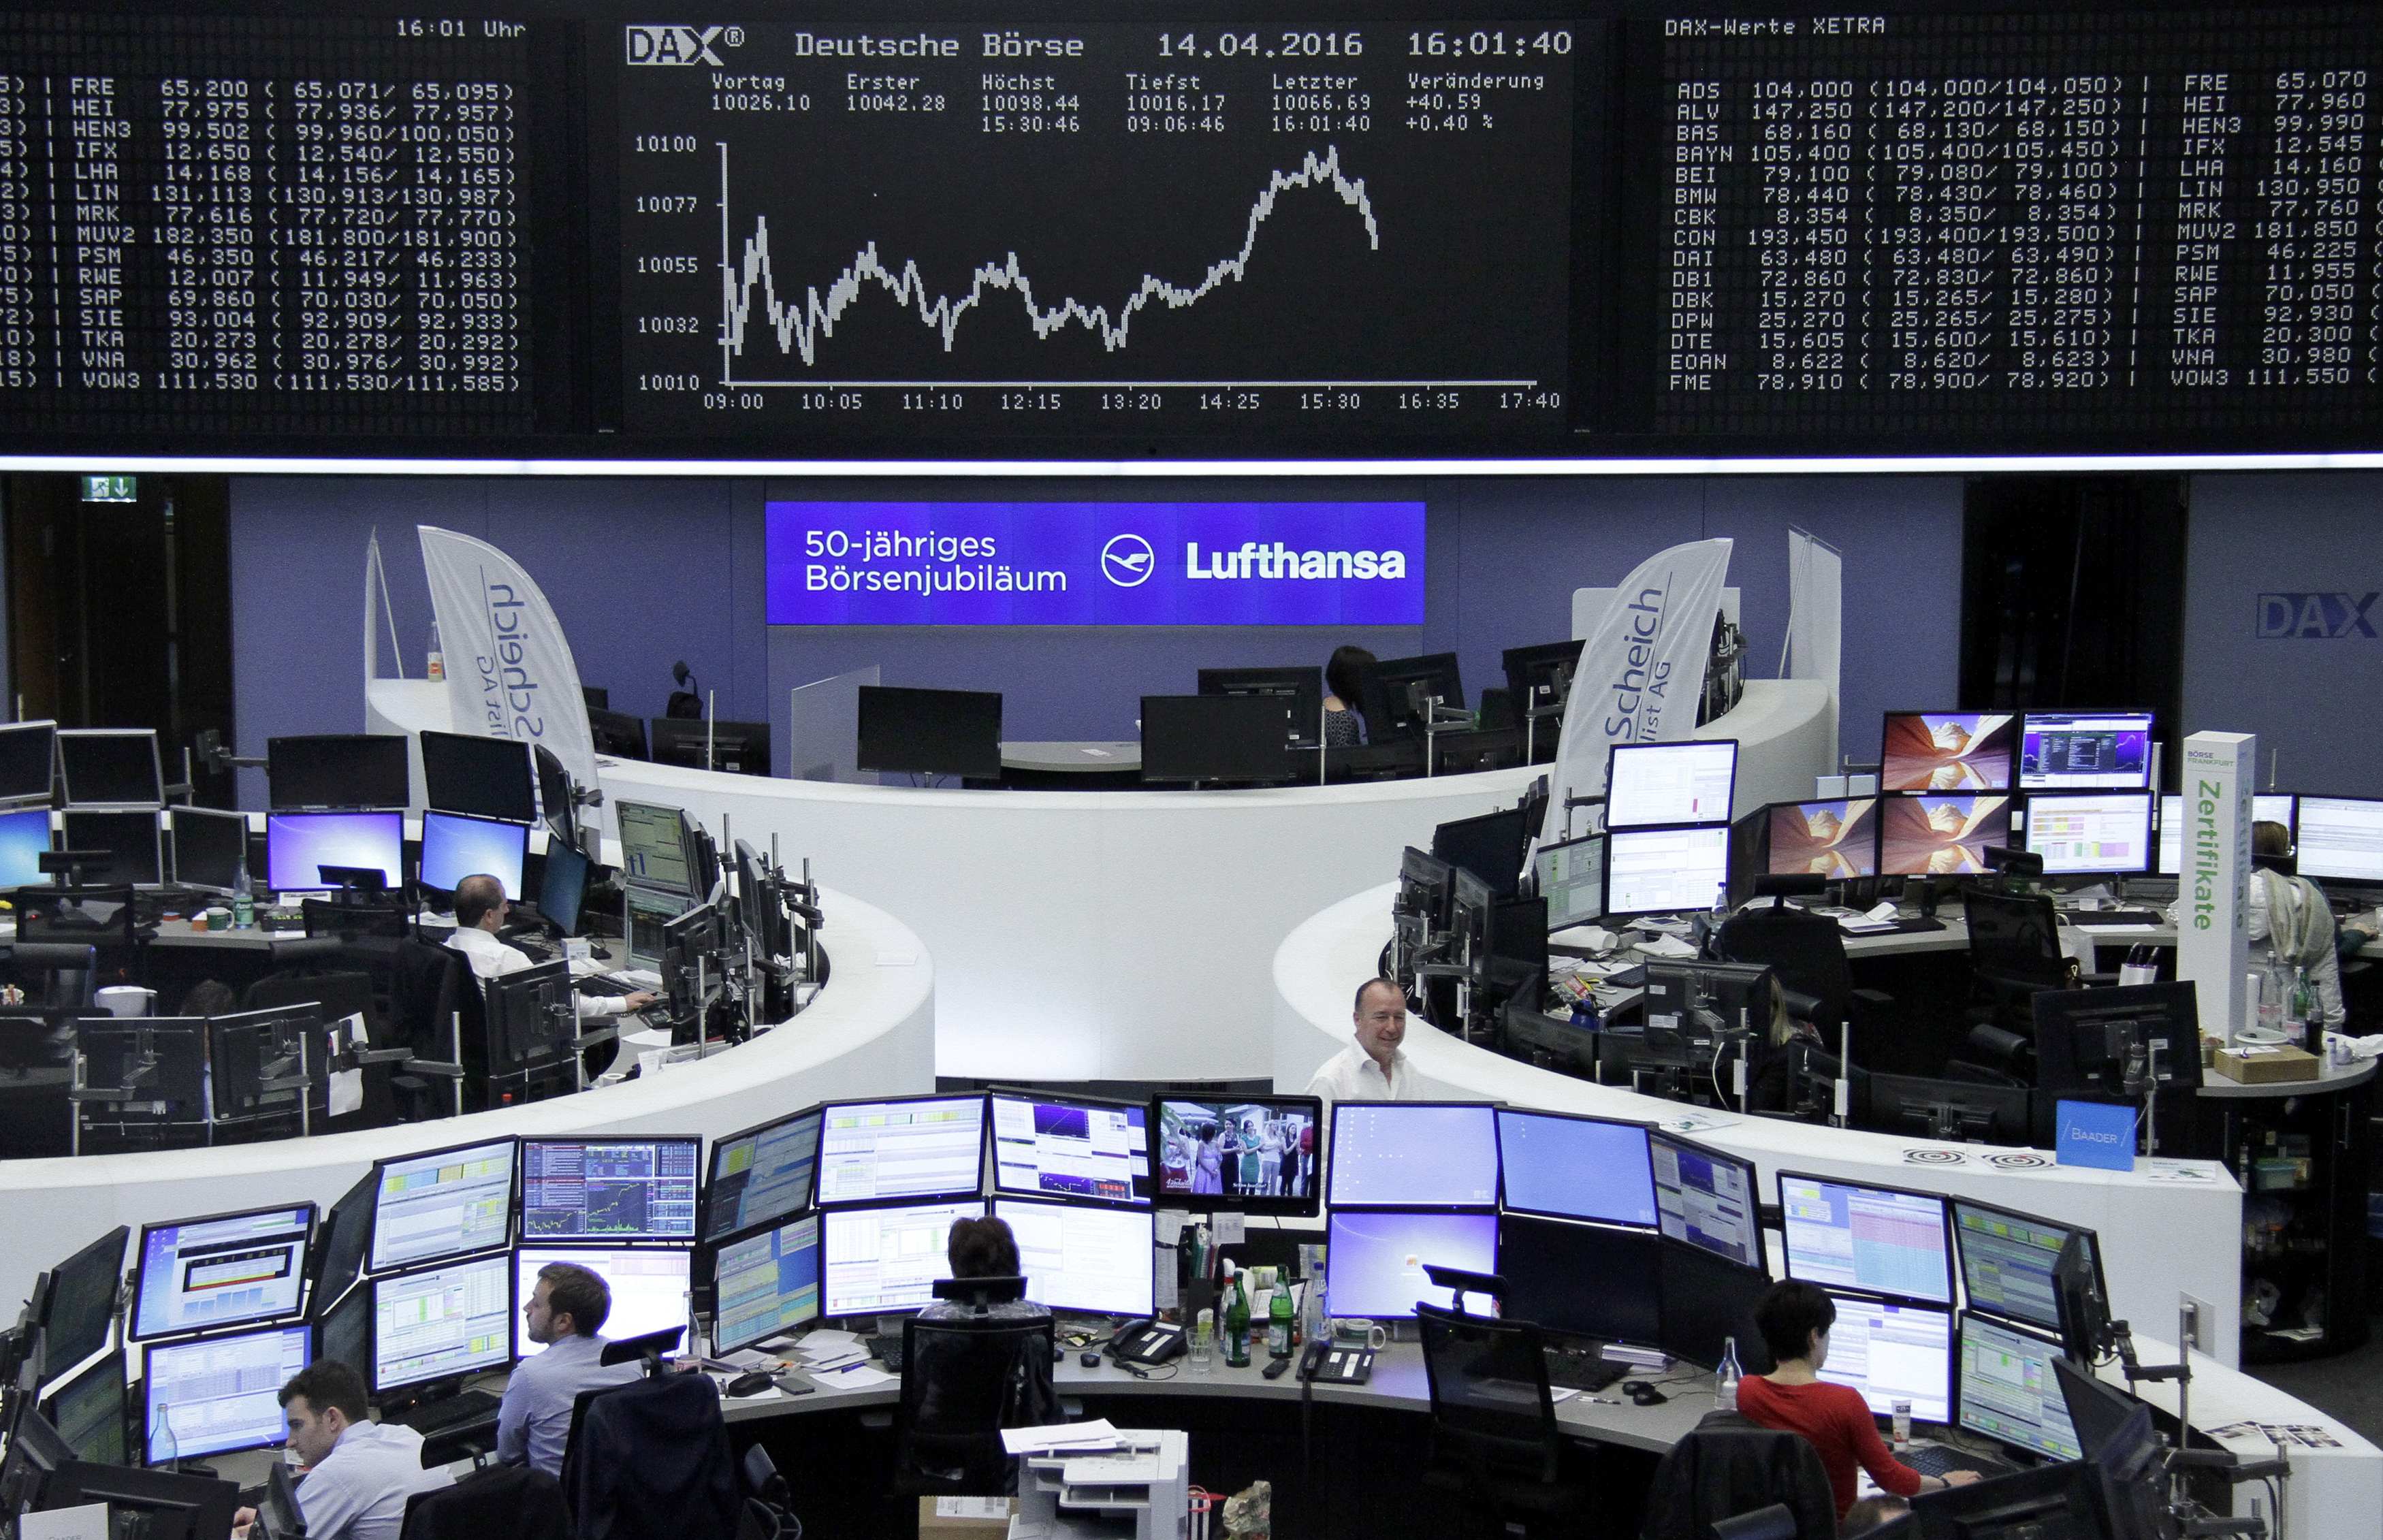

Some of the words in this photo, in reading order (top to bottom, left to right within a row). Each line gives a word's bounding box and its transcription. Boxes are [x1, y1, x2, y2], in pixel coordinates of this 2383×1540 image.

[398, 20, 465, 37] 16:01
[484, 20, 526, 37] Uhr
[1665, 18, 1795, 36] DAX-Werte
[1813, 17, 1885, 34] XETRA
[795, 33, 959, 57] Deutsche
[982, 31, 1084, 57] Börse
[1159, 33, 1362, 59] 14.04.2016
[1409, 31, 1571, 57] 16:01:40
[71, 78, 114, 95] FRE
[161, 79, 248, 97] 65,200
[712, 73, 785, 92] Vortag
[848, 73, 920, 90] Erster
[982, 74, 1055, 91] Höchst
[1125, 74, 1200, 90] Tiefst
[1273, 74, 1358, 90] Letzter
[1409, 72, 1544, 91] Veränderung
[1678, 82, 1720, 99] ADS
[1754, 81, 1853, 99] 104,000
[2185, 74, 2228, 91] FRE
[2276, 71, 2366, 89] 65,070
[72, 99, 113, 116] HEI
[162, 100, 249, 118] 77,975
[1678, 103, 1719, 121] ALV
[1753, 102, 1852, 120] 147,250
[2184, 95, 2225, 113] HEI
[2275, 92, 2365, 110] 77,960
[73, 121, 131, 138] HEN3
[163, 122, 249, 140] 99,502
[982, 116, 1080, 132] 15:30:46
[1127, 116, 1224, 132] 09:06:46
[1273, 115, 1370, 132] 16:01:40
[1483, 114, 1492, 131] %
[2183, 116, 2241, 134] HEN3
[2274, 114, 2363, 132] 99,990
[1677, 125, 1718, 142] BAS
[1765, 123, 1851, 141] 68,160
[76, 141, 117, 159] IFX
[165, 143, 251, 161] 12,650
[637, 135, 696, 153] 10100
[2184, 138, 2224, 155] IFX
[2275, 135, 2362, 153] 12,545
[1676, 146, 1732, 163] BAYN
[1751, 144, 1850, 162] 105,400
[75, 163, 118, 180] LHA
[167, 164, 251, 182] 14,168
[1676, 166, 1715, 183] BEI
[1764, 165, 1849, 182] 79,100
[2181, 159, 2224, 176] LHA
[2273, 157, 2361, 175] 14,160
[76, 184, 118, 201] LIN
[153, 185, 252, 203] 131,113
[1675, 188, 1716, 204] BMW
[1763, 187, 1849, 204] 78,440
[2179, 180, 2222, 197] LIN
[2257, 178, 2360, 196] 130,950
[637, 196, 697, 212] 10077
[2178, 202, 2221, 219] MRK
[2270, 199, 2358, 217] 77,760
[76, 205, 119, 222] MRK
[166, 206, 253, 224] 77,616
[1674, 208, 1716, 225] CBK
[1777, 208, 1848, 224] 8,354
[78, 226, 135, 243] MUV2
[154, 227, 253, 244] 182,350
[1674, 229, 1715, 246] CON
[1749, 228, 1847, 246] 193,450
[2177, 223, 2235, 240] MUV2
[2255, 220, 2357, 238] 181,850
[78, 246, 121, 263] PSM
[167, 248, 253, 266] 46,350
[1674, 250, 1712, 267] DAI
[1761, 249, 1846, 266] 63,480
[2177, 244, 2219, 261] PSM
[2267, 241, 2356, 259] 46,225
[639, 257, 698, 273] 10055
[2175, 265, 2218, 282] RWE
[2268, 262, 2355, 280] 11,955
[79, 268, 122, 285] RWE
[170, 269, 254, 286] 12,007
[1673, 271, 1712, 287] DB1
[1761, 270, 1846, 287] 72,860
[80, 289, 122, 305] SAP
[169, 289, 255, 307] 69,860
[1672, 291, 1714, 308] DBK
[1762, 291, 1845, 308] 15,270
[2175, 286, 2217, 303] SAP
[2266, 283, 2354, 301] 70,050
[81, 309, 123, 326] SIE
[170, 310, 255, 327] 93,004
[1672, 312, 1713, 329] DPW
[1759, 311, 1844, 328] 25,270
[2173, 307, 2216, 323] SIE
[2265, 305, 2352, 322] 92,930
[639, 317, 699, 333] 10032
[82, 330, 124, 347] TKA
[170, 331, 256, 349] 20,273
[1671, 333, 1712, 349] DTE
[1761, 332, 1844, 349] 15,605
[2173, 328, 2215, 344] TKA
[2263, 325, 2352, 343] 20,300
[82, 351, 125, 368] VNA
[171, 352, 257, 369] 30,962
[1671, 353, 1727, 370] EOAN
[1772, 353, 1843, 369] 8,622
[2172, 349, 2214, 365] VNA
[2262, 347, 2350, 364] 30,980
[83, 372, 140, 389] VOW3
[159, 372, 257, 390] 111,530
[640, 374, 699, 391] 10010
[1670, 374, 1711, 391] FME
[1757, 374, 1842, 390] 78,910
[2171, 369, 2228, 386] VOW3
[2248, 368, 2350, 385] 111,550
[704, 394, 763, 409] 09:00
[803, 394, 862, 409] 10:05
[903, 394, 962, 410] 11:10
[1002, 394, 1061, 410] 12:15
[1102, 394, 1161, 410] 13:20
[1200, 394, 1260, 410] 14:25
[1301, 394, 1360, 409] 15:30
[1399, 393, 1458, 409] 16:35
[1501, 393, 1560, 408] 17:40
[805, 530, 995, 562] 50-jähriges
[1187, 542, 1405, 580] Lufthansa
[806, 564, 1066, 596] Börsenjubiläum
[2256, 592, 2380, 639] DAX
[1605, 588, 1662, 740] Scheich
[1648, 661, 1671, 699] AG
[2188, 758, 2235, 767] FRANKFURT
[2193, 780, 2221, 931] Zertifikate
[2070, 1127, 2118, 1144] BAADER
